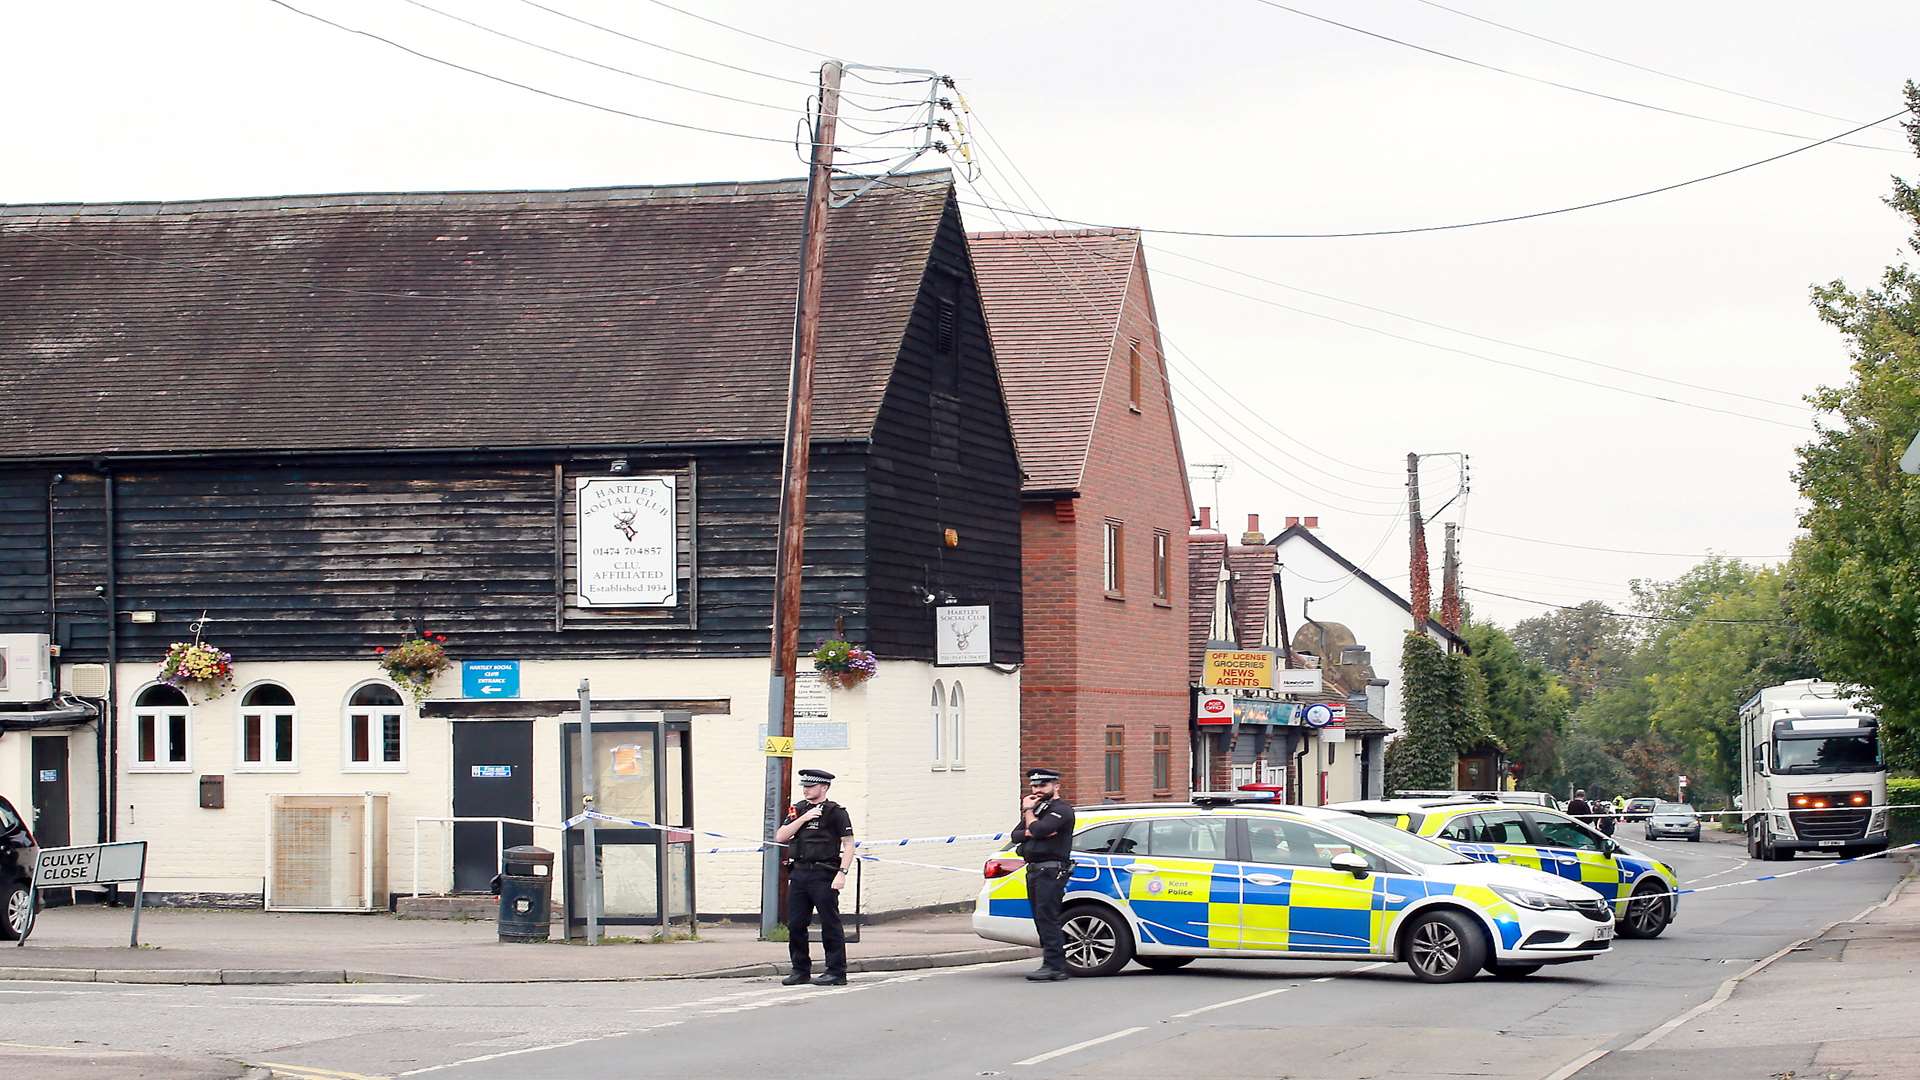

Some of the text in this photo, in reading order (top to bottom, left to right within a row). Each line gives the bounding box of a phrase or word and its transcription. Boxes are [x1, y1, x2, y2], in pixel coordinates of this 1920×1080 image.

[595, 485, 657, 499] HARTLEY
[584, 496, 669, 517] SOCIAL CLUB
[592, 547, 662, 556] 01474 704857
[593, 571, 664, 580] AFFILIATED
[589, 584, 667, 593] Established 1934
[1212, 652, 1267, 661] OFF LICENSE
[1213, 660, 1265, 668] GROCERIES
[1223, 669, 1255, 677] NEWS
[1217, 678, 1260, 686] AGENTS
[41, 852, 95, 867] CULVEY
[44, 866, 88, 880] CLOSE
[1168, 888, 1193, 896] Police
